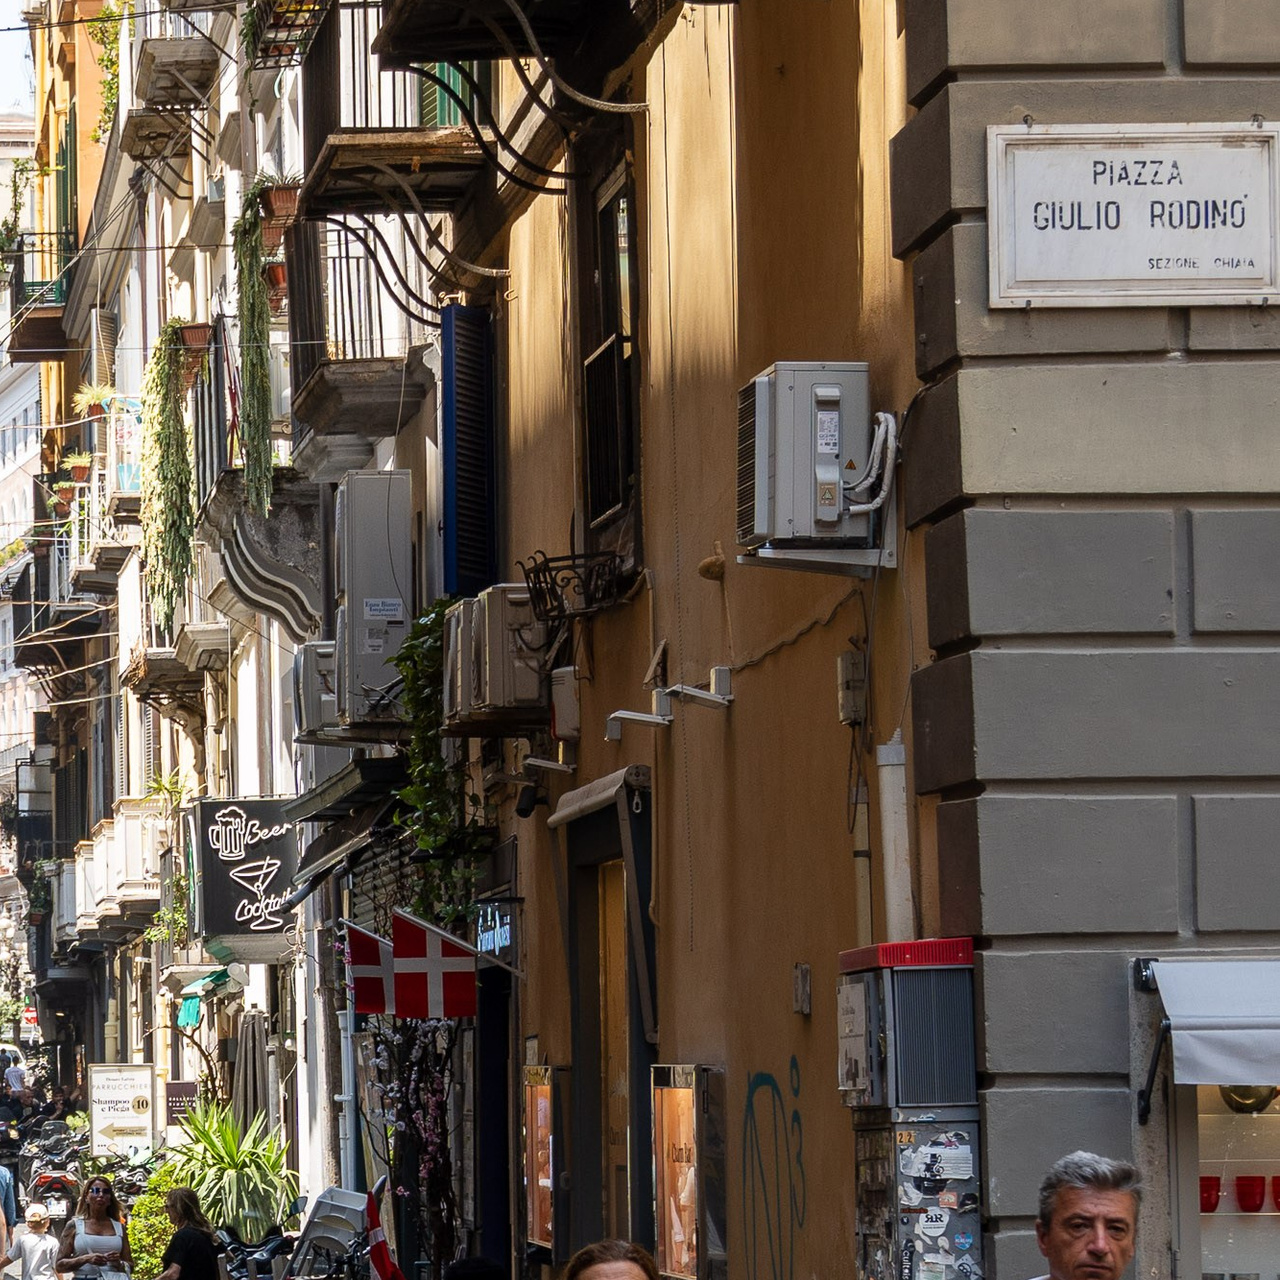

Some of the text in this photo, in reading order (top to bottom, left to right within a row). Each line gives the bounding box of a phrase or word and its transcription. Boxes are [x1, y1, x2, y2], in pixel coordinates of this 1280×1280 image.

[1093, 160, 1182, 185] PIAZZA
[1034, 201, 1120, 230] GIULIO
[244, 820, 292, 844] Beer
[108, 1105, 130, 1113] Piega
